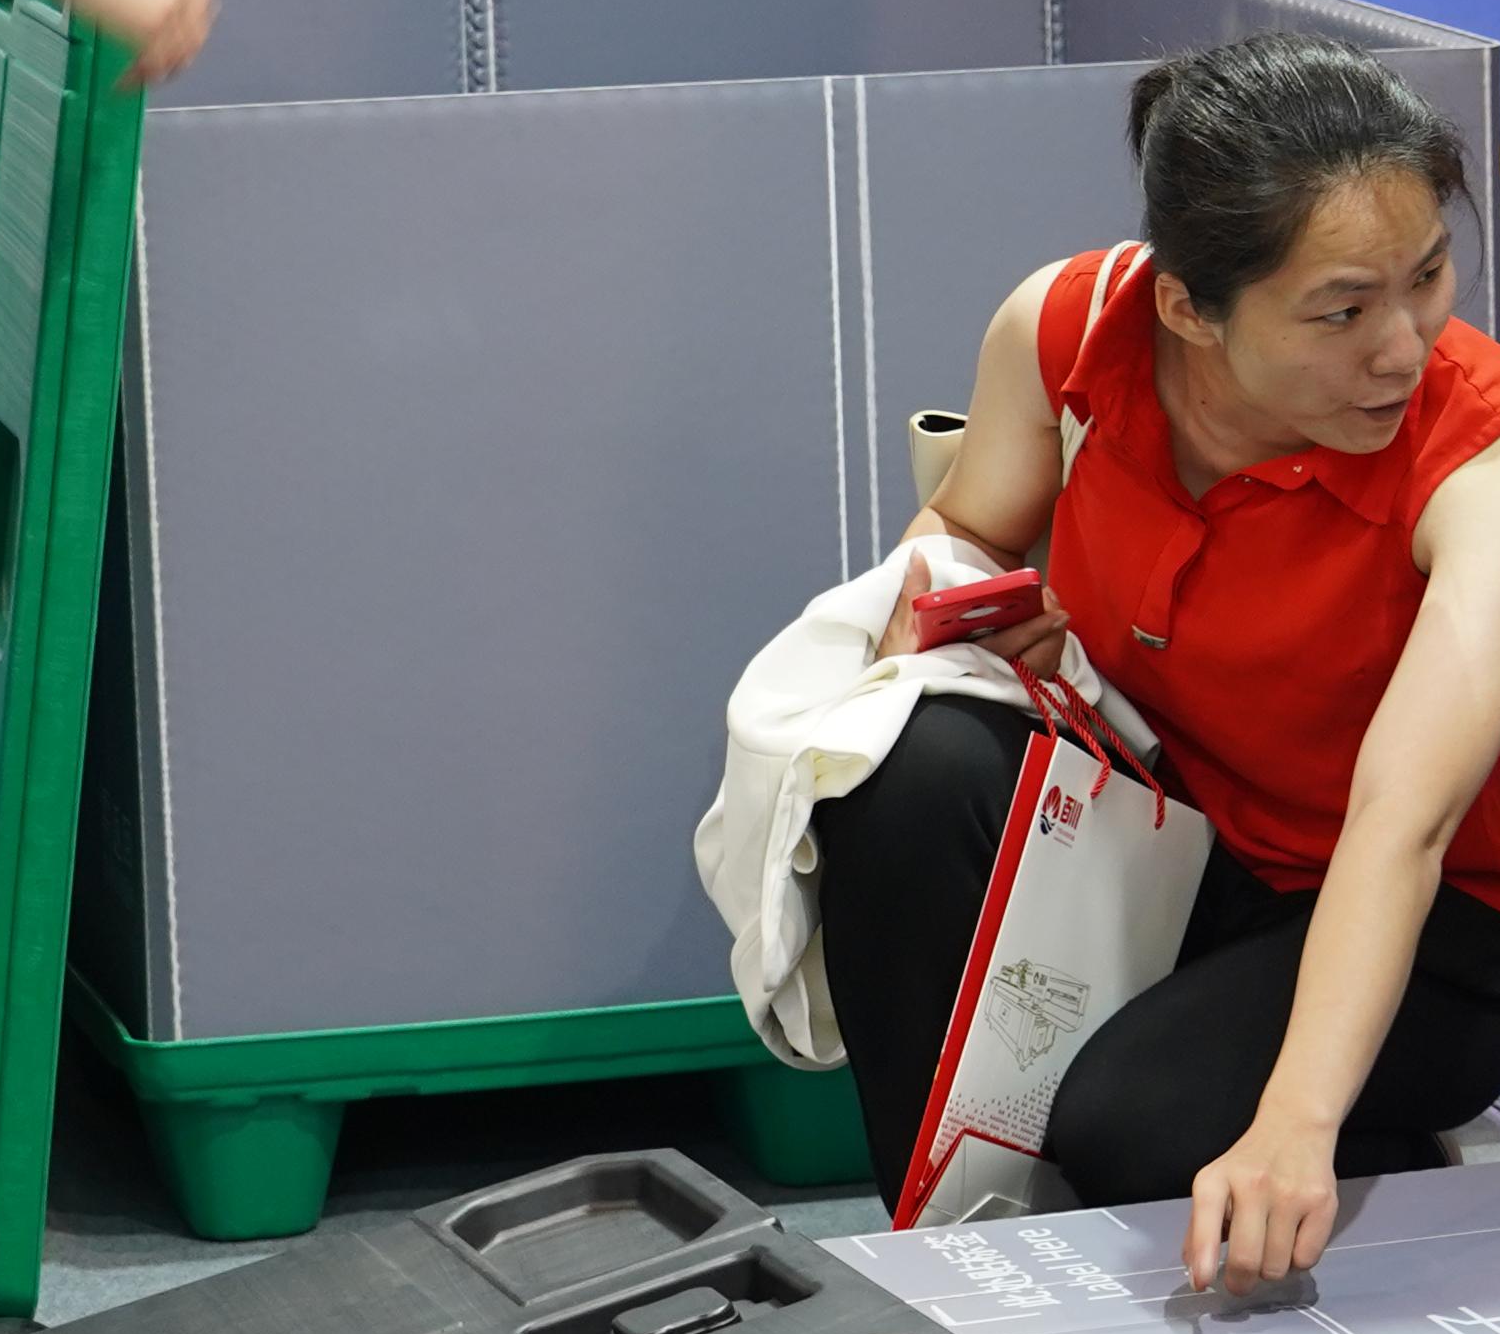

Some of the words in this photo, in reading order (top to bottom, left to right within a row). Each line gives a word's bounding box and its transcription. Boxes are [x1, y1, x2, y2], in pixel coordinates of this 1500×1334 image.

[1017, 1227, 1084, 1263] Here
[922, 1230, 1063, 1309] 此处贴标签
[1045, 1262, 1134, 1302] Label
